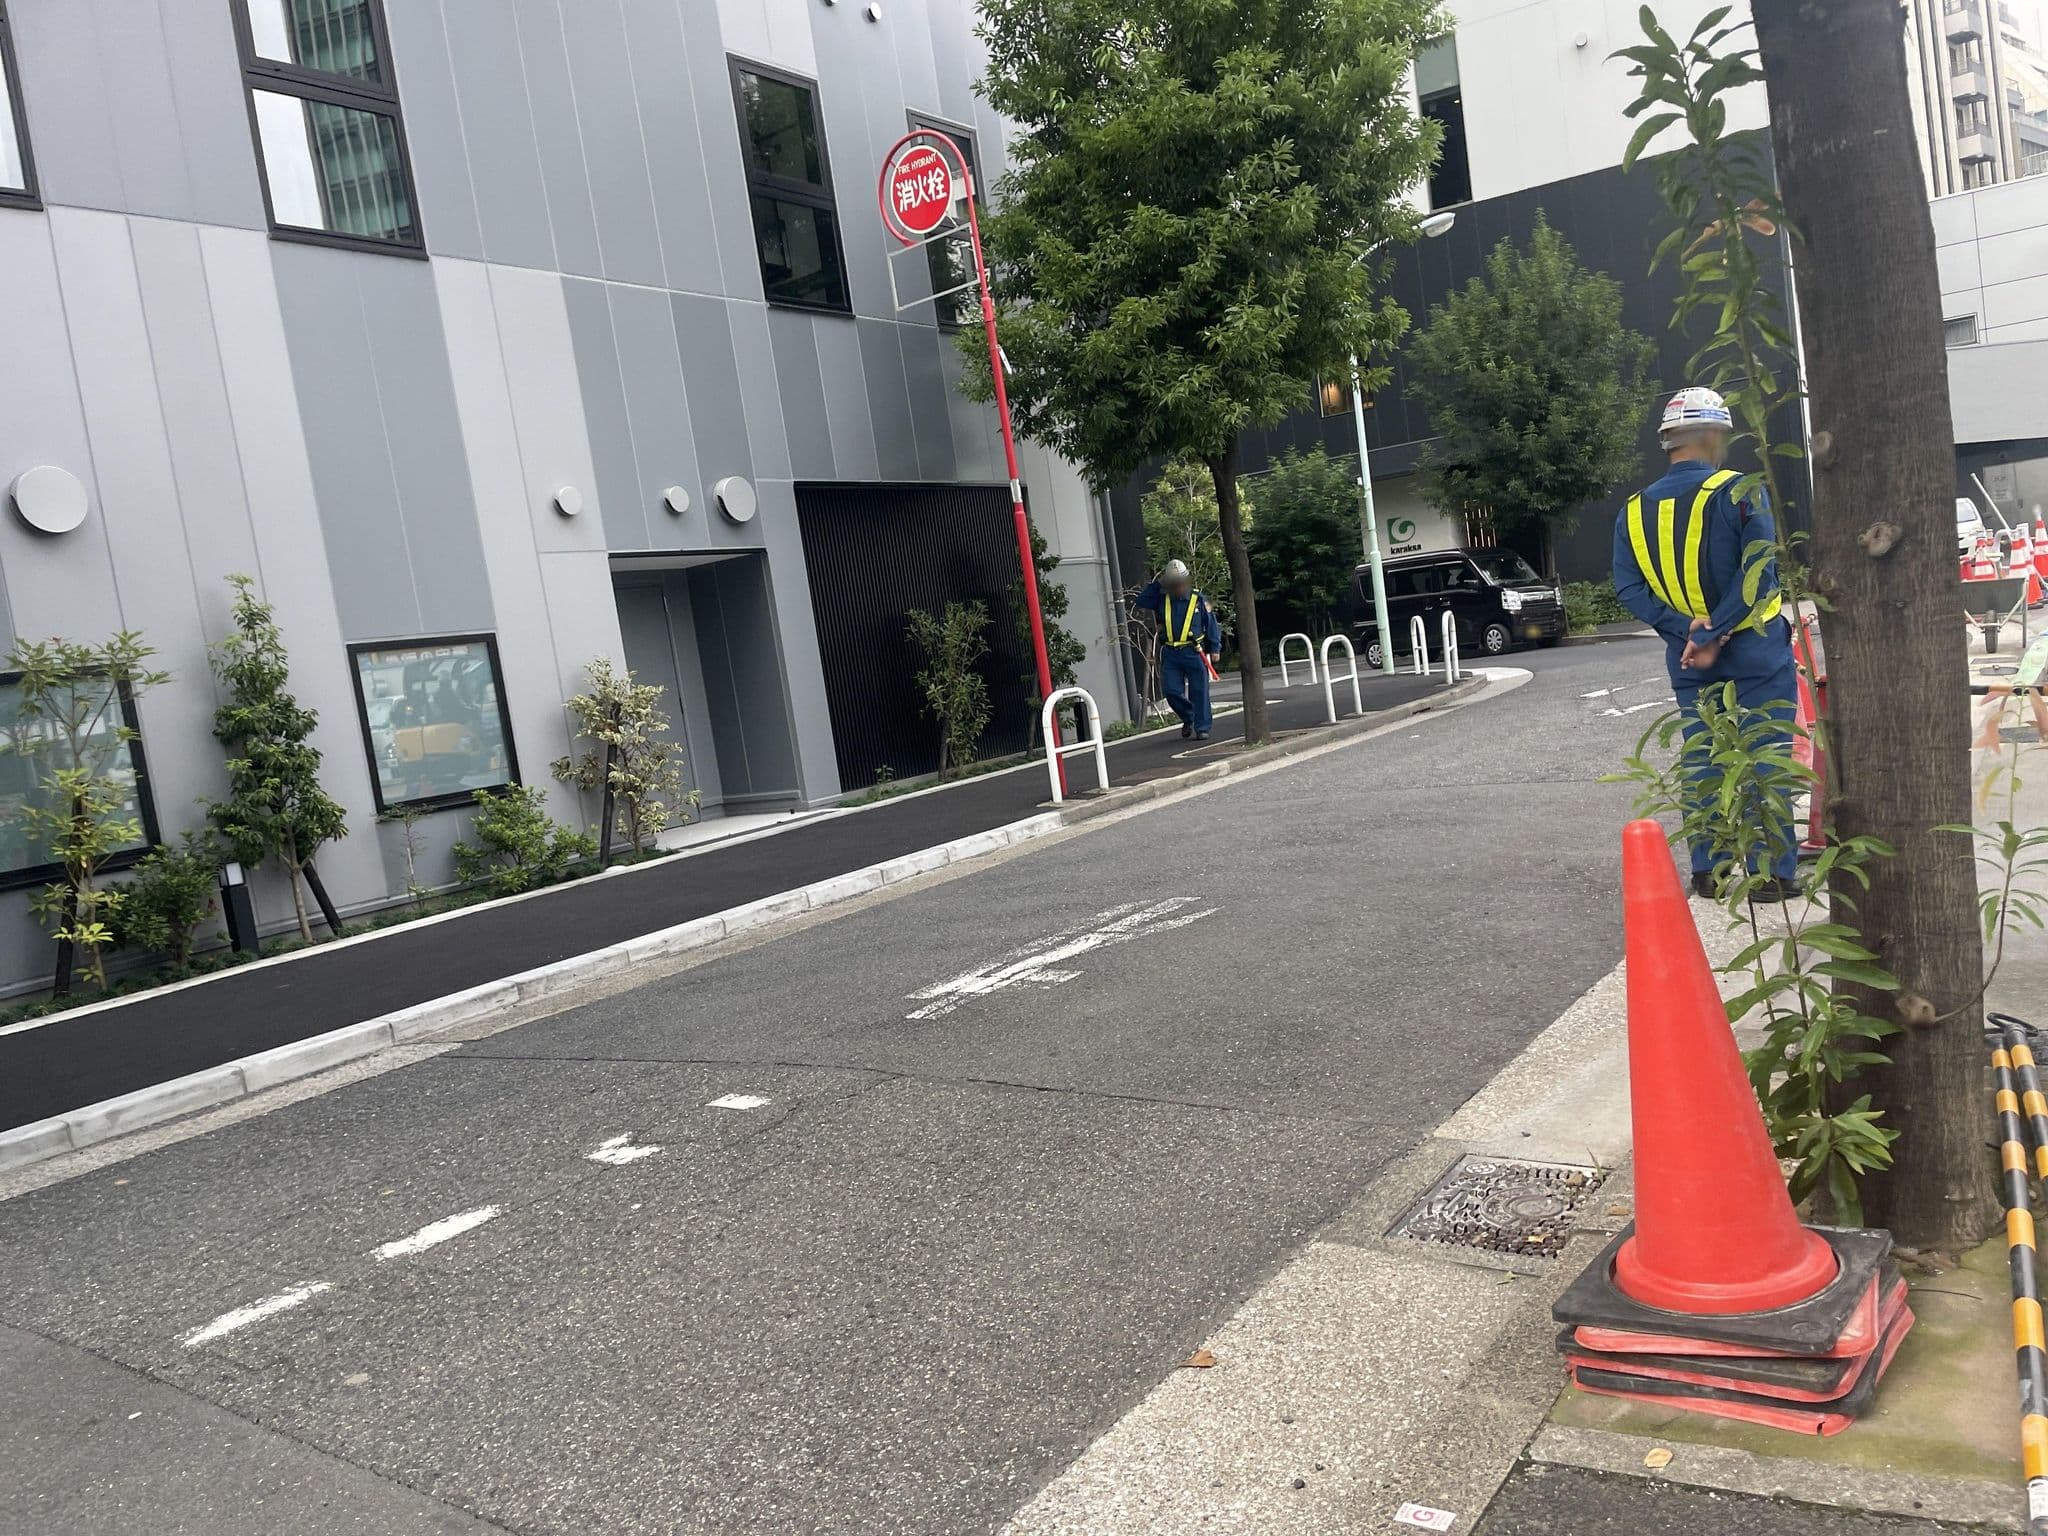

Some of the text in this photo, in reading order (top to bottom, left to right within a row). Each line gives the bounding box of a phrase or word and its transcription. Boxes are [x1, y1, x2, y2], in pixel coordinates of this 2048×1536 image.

[898, 153, 937, 175] FIRE HYDRANT
[896, 167, 947, 213] 消火栓
[1390, 543, 1422, 555] karaksa
